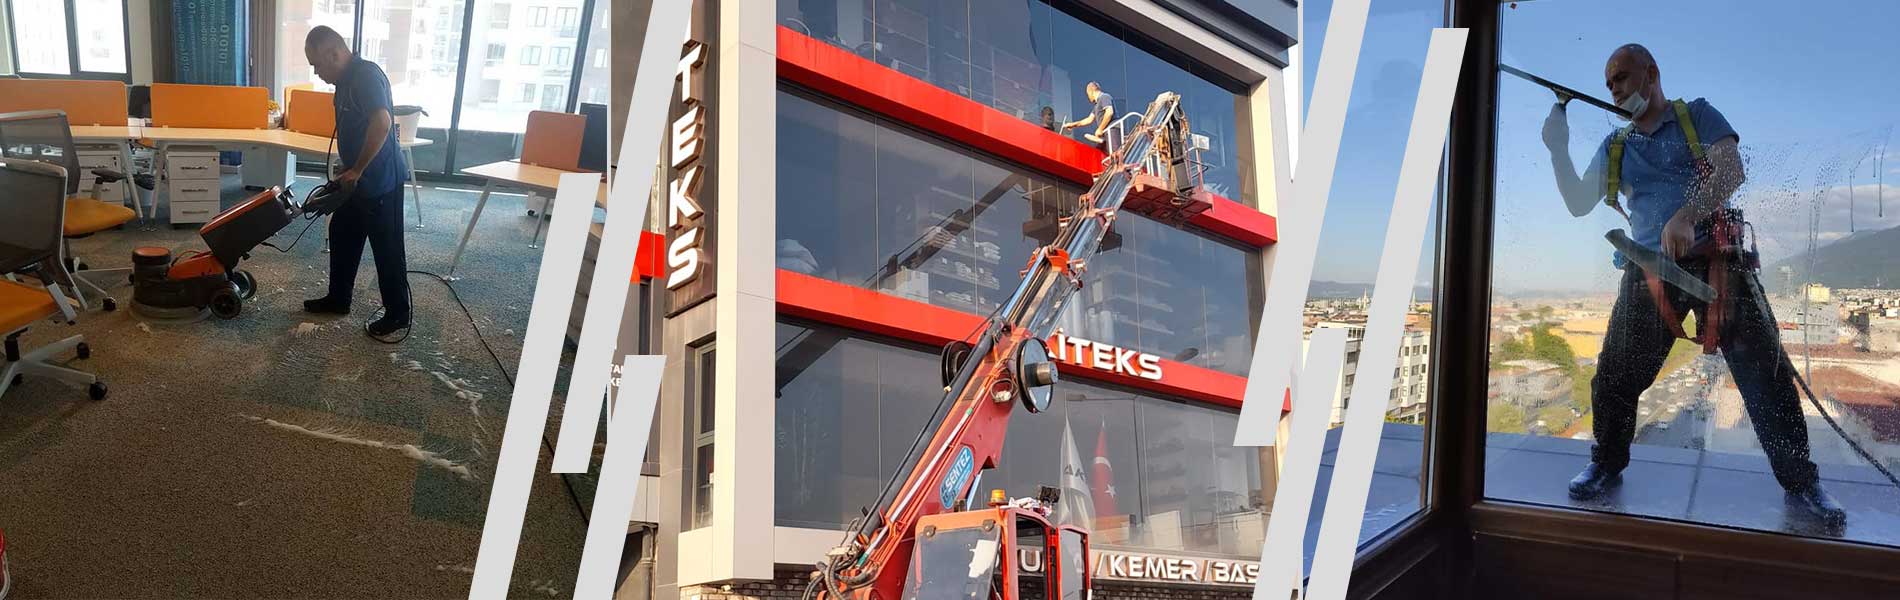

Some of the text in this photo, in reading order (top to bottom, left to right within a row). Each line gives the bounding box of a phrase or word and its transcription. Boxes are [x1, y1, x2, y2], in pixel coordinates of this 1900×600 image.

[666, 14, 704, 291] TEKS
[945, 449, 971, 492] SENTEZ
[1110, 555, 1198, 580] KEMER
